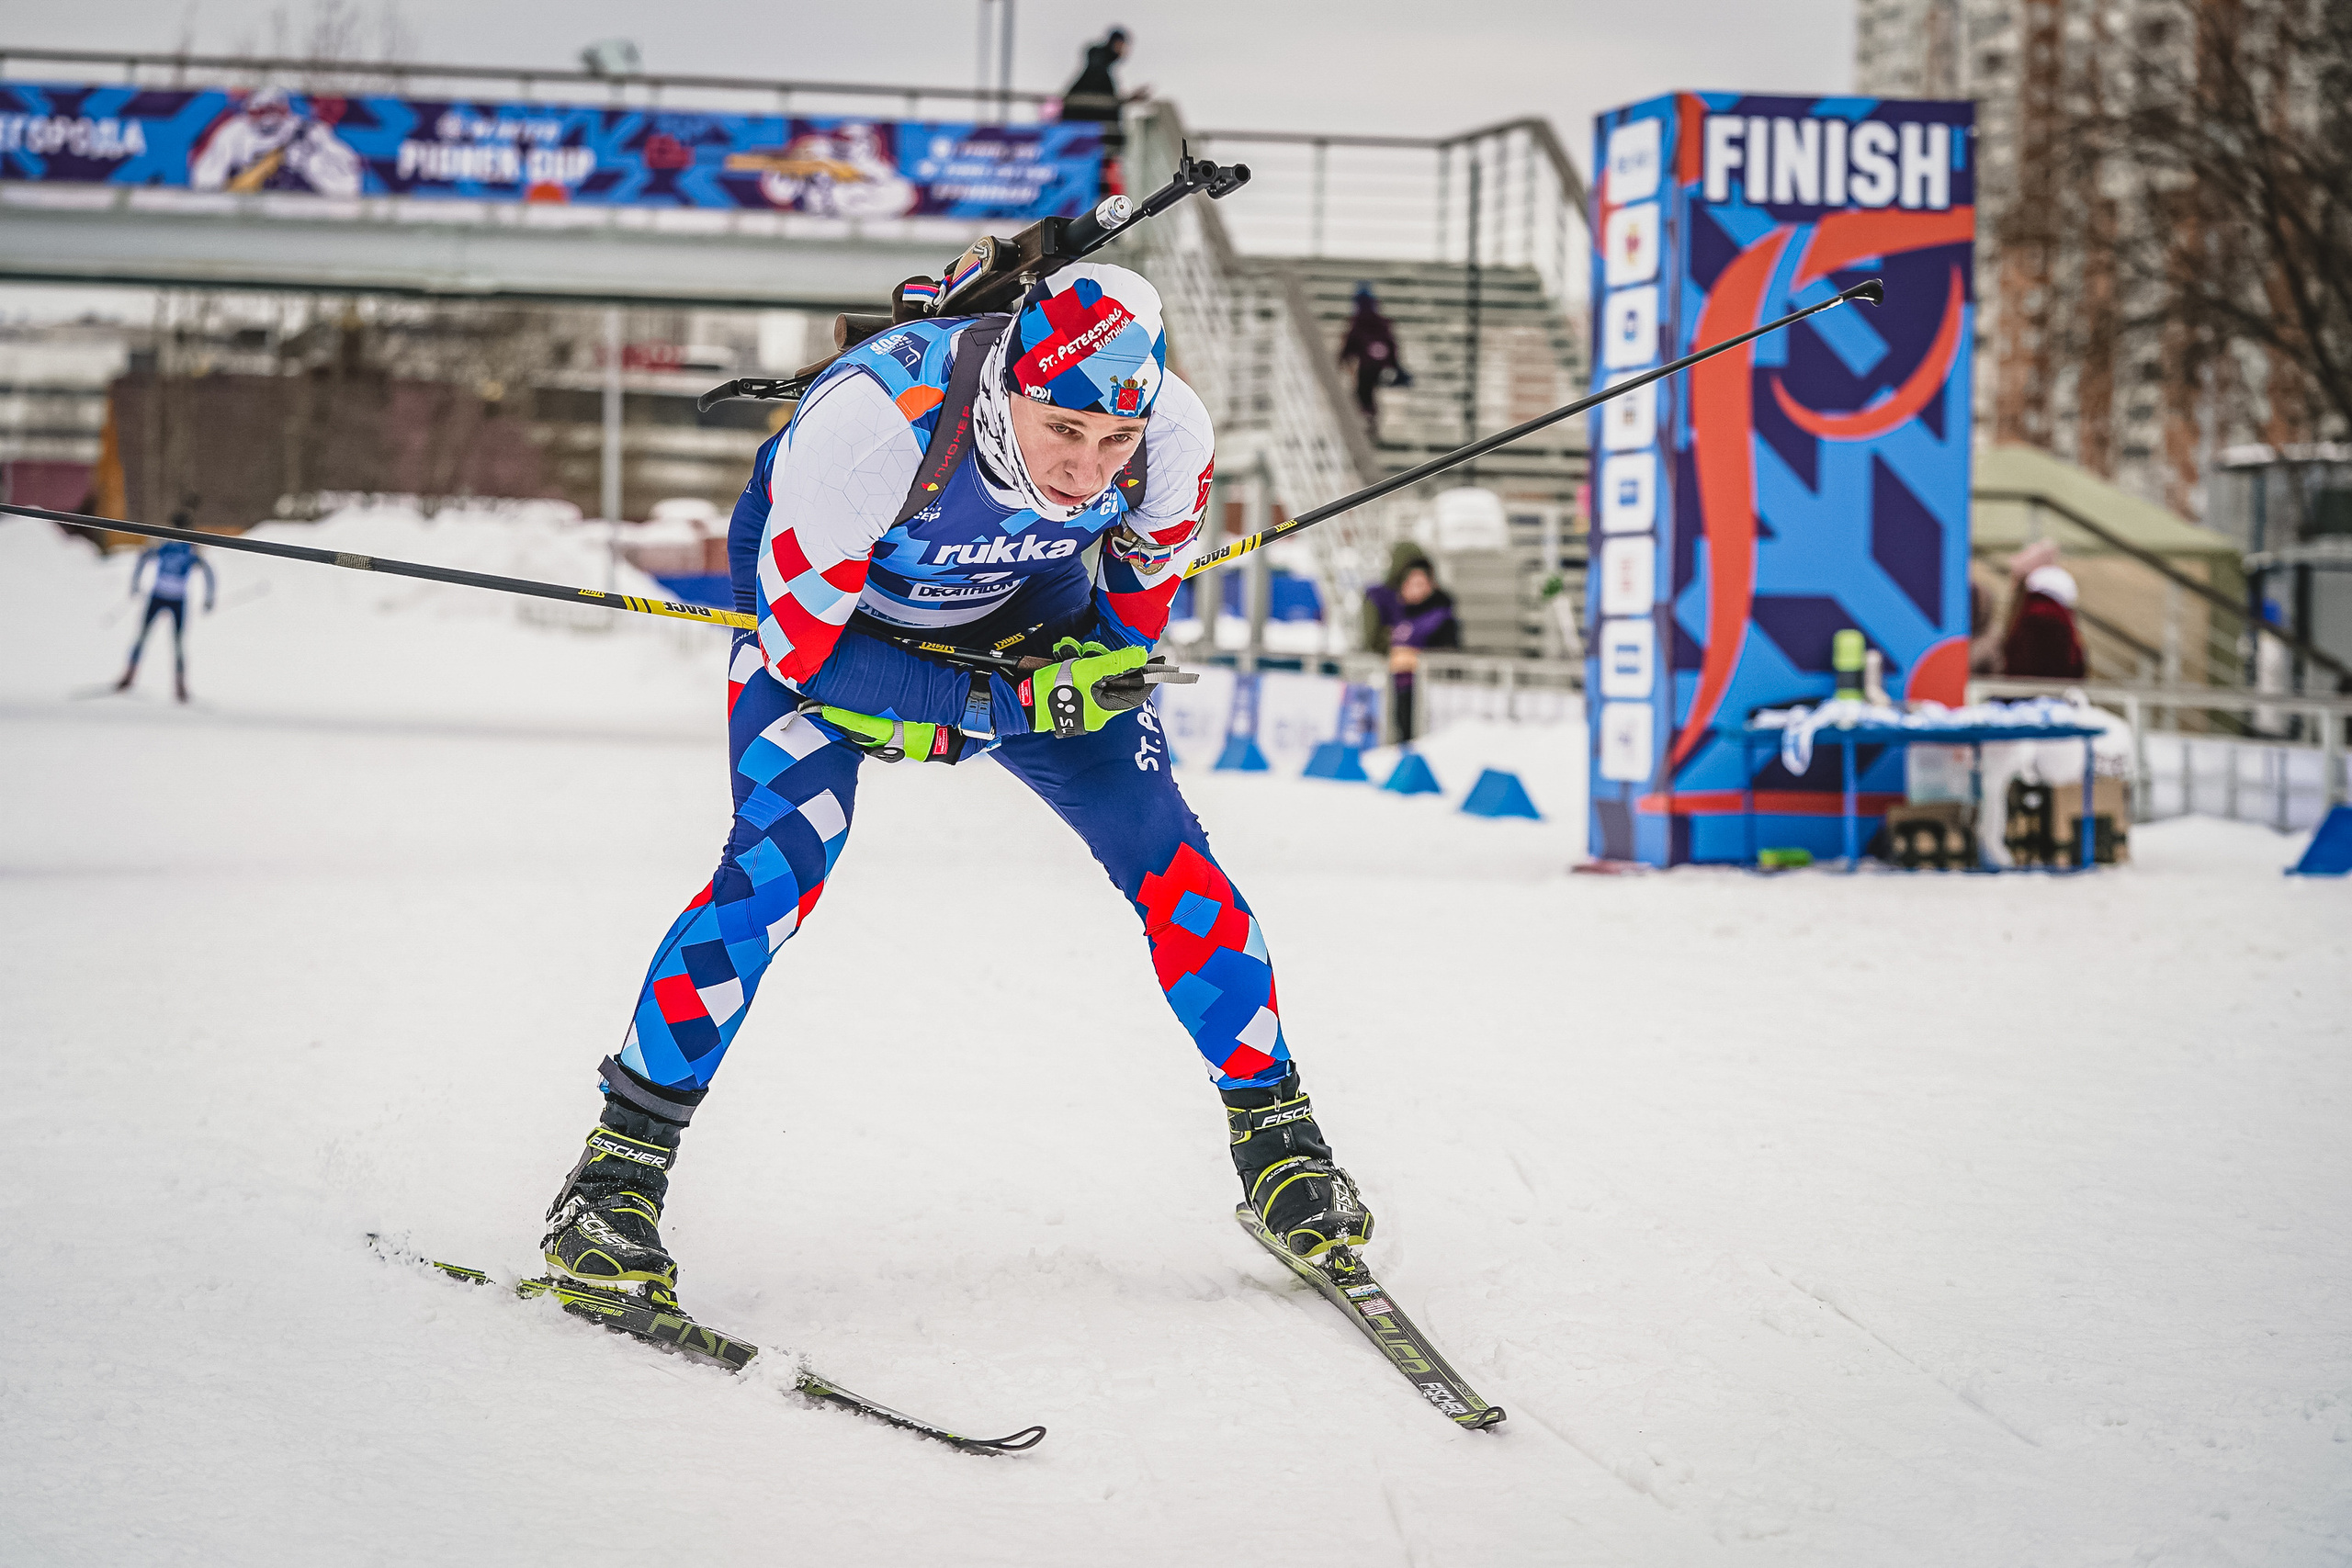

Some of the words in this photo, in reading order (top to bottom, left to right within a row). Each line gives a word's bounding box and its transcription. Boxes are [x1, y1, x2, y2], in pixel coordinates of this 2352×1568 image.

[1703, 115, 1951, 209] FINISH
[1037, 354, 1058, 373] ST.
[1057, 307, 1124, 361] PETERSBURG
[1091, 315, 1132, 353] BIATHLON
[934, 405, 970, 478] ПИОНЕР
[932, 534, 1079, 565] rukka
[1192, 545, 1231, 570] RACE
[917, 579, 1017, 598] DECATHLON
[662, 601, 713, 617] RACE
[918, 641, 956, 654] START
[992, 632, 1026, 651] START
[1134, 735, 1162, 772] ST.
[590, 1136, 668, 1168] FISCHER
[1419, 1382, 1469, 1416] FISCHER
